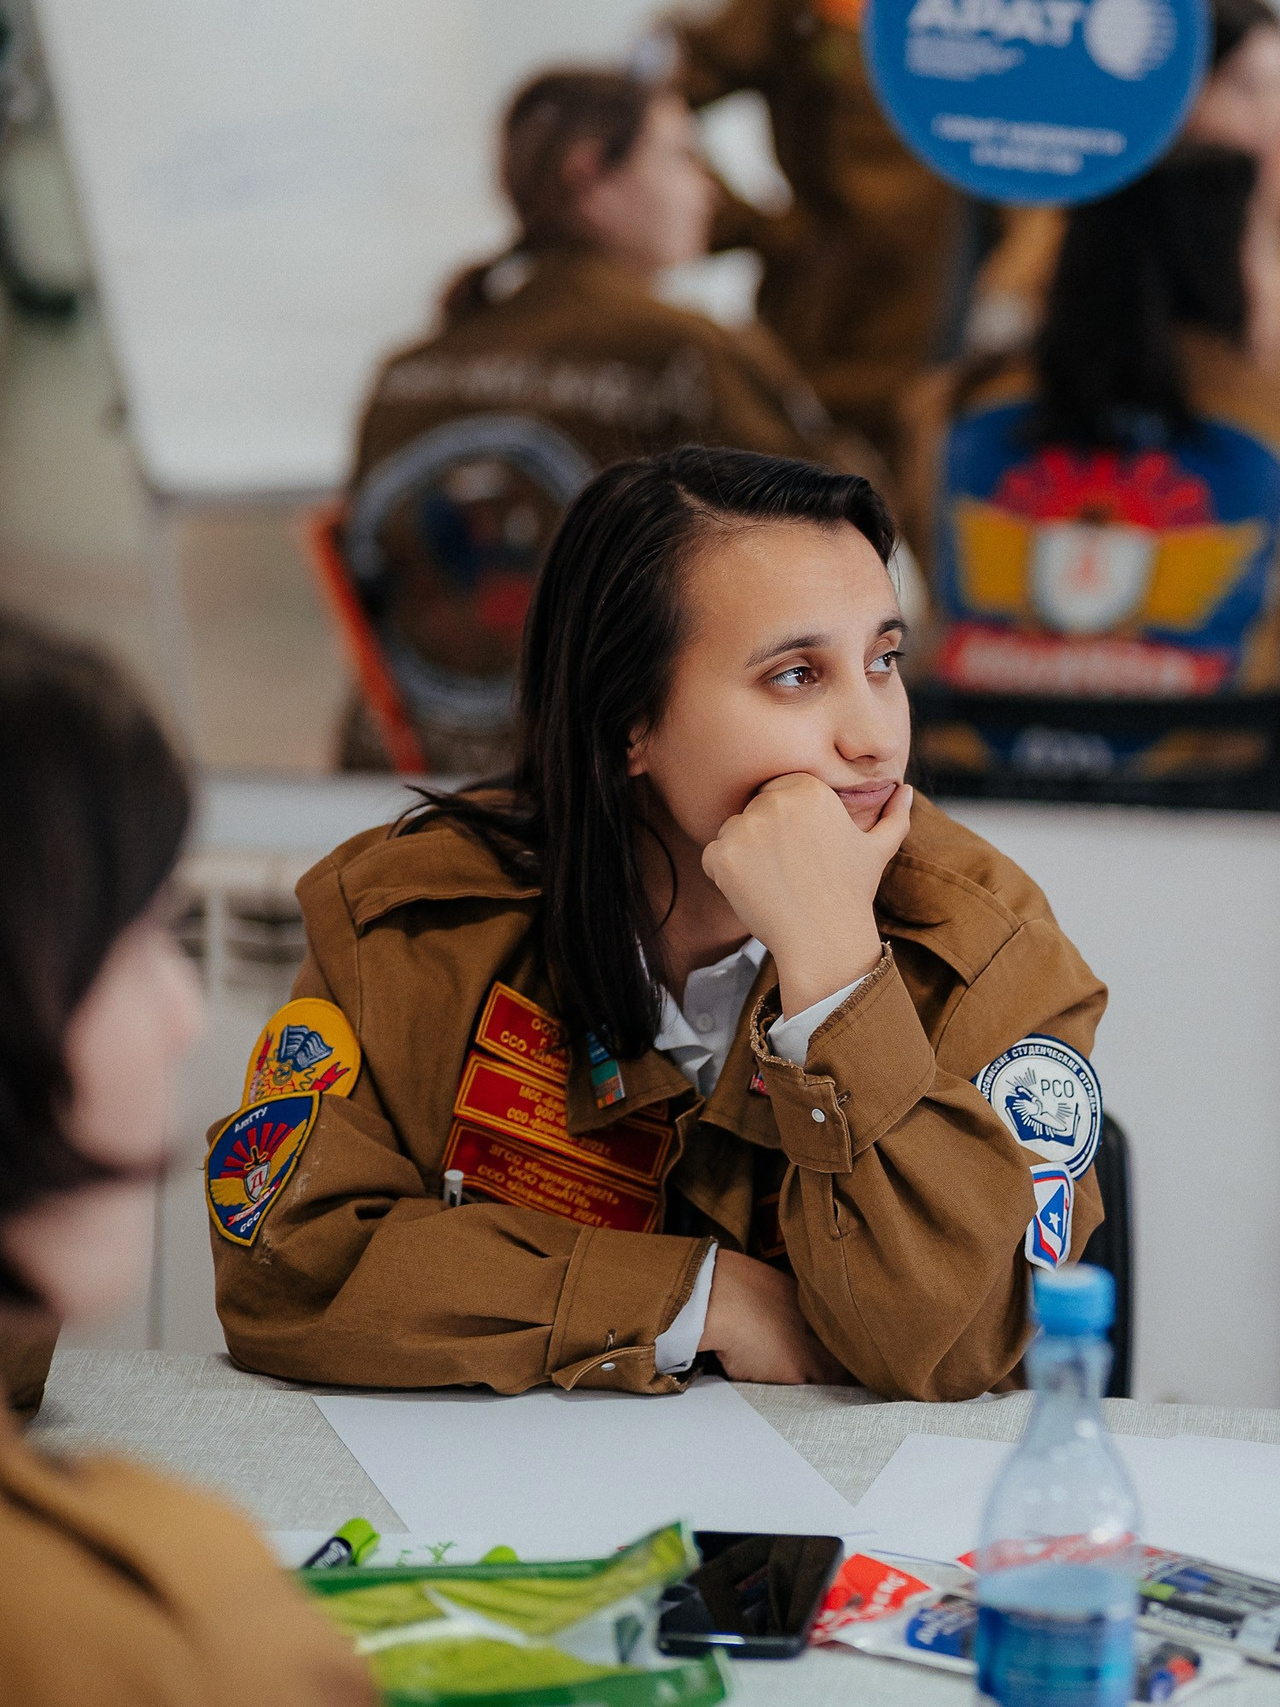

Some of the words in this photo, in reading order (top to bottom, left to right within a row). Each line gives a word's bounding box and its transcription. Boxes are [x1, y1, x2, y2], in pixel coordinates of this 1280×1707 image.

[500, 1031, 528, 1052] ССО
[982, 1053, 1011, 1099] ОССИЙСКИЕ
[1011, 1045, 1080, 1072] СТУДЕНЧЕСКИЕ
[1078, 1069, 1097, 1113] ОТРЯДЫ
[1040, 1079, 1075, 1099] РСО
[507, 1107, 530, 1124] ССО
[477, 1164, 505, 1185] ССО
[508, 1166, 538, 1185] ООО
[239, 1211, 261, 1233] ССО
